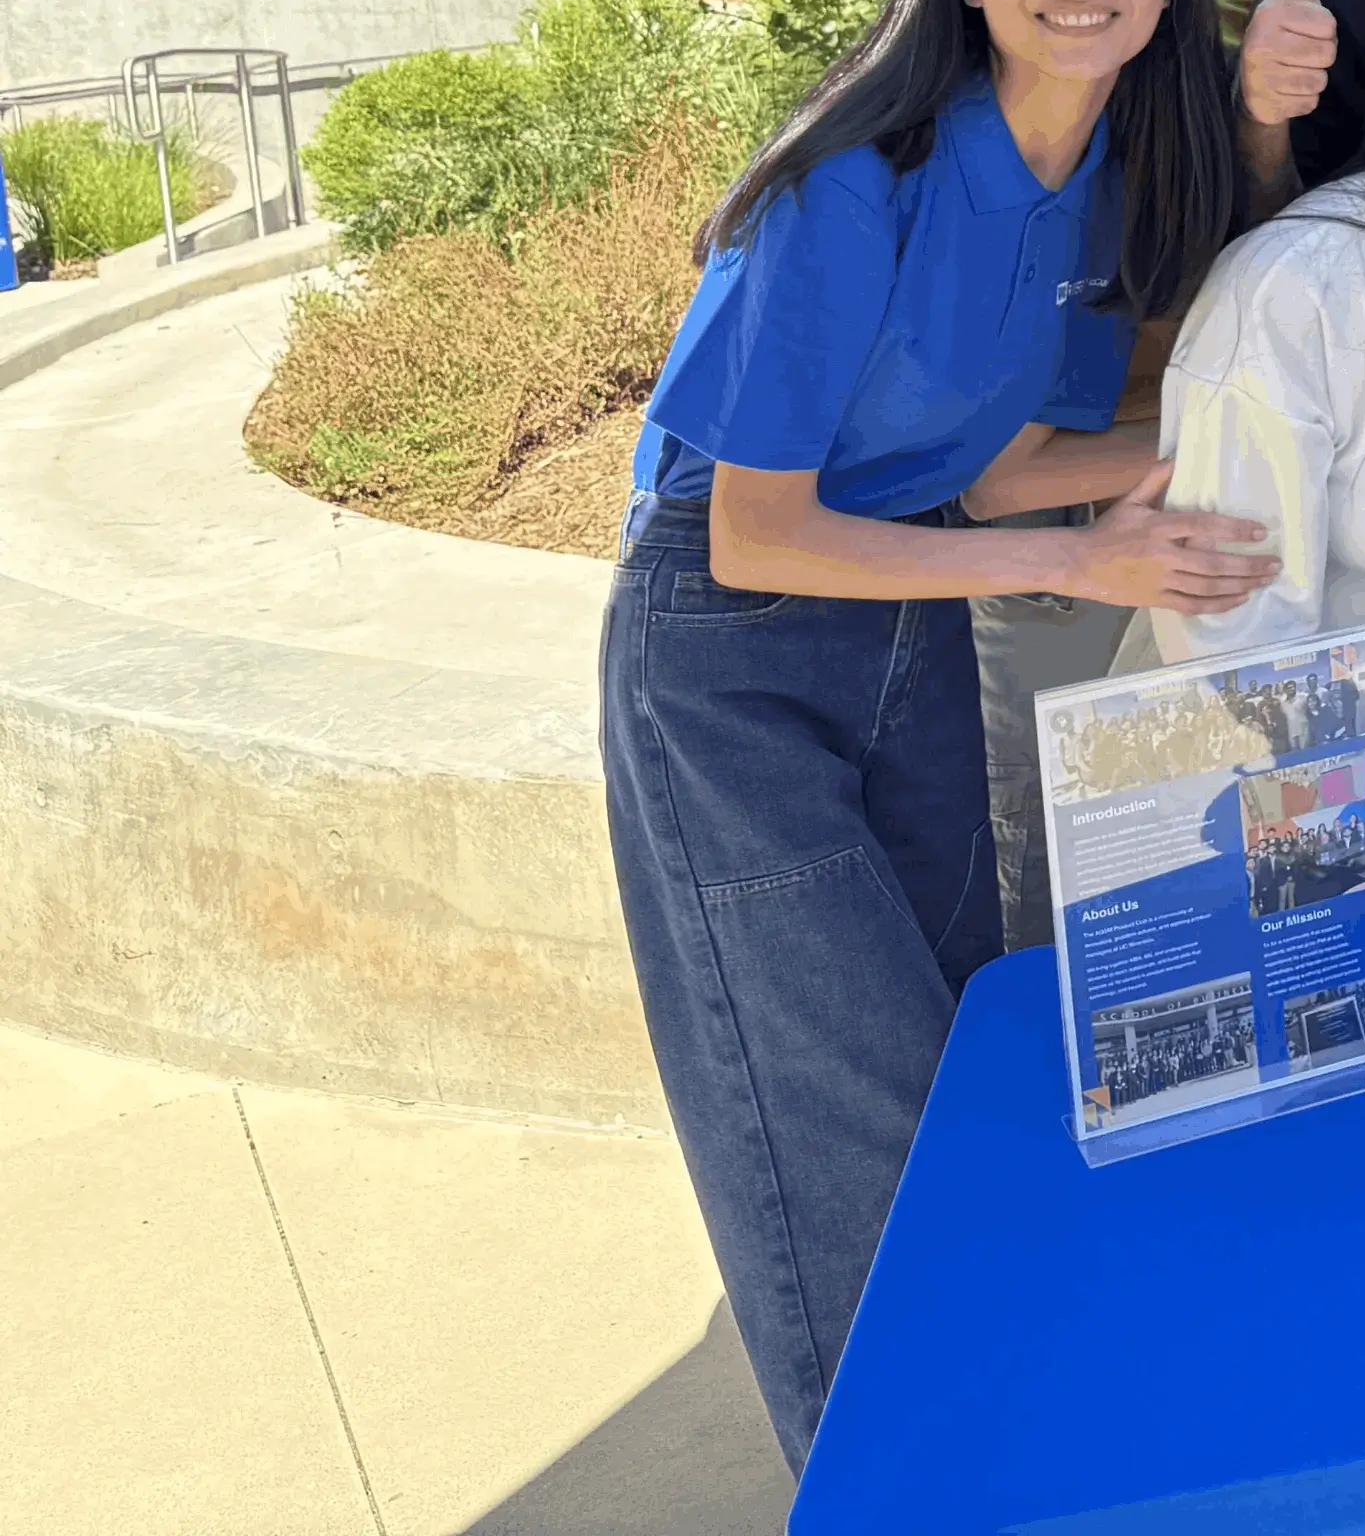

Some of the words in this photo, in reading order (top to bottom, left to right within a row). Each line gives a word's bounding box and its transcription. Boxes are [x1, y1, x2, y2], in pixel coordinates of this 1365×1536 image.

[1072, 798, 1157, 826] Introduction
[1082, 904, 1120, 923] About
[1122, 899, 1139, 912] Us
[1261, 920, 1283, 933] Our
[1286, 908, 1332, 927] Mission
